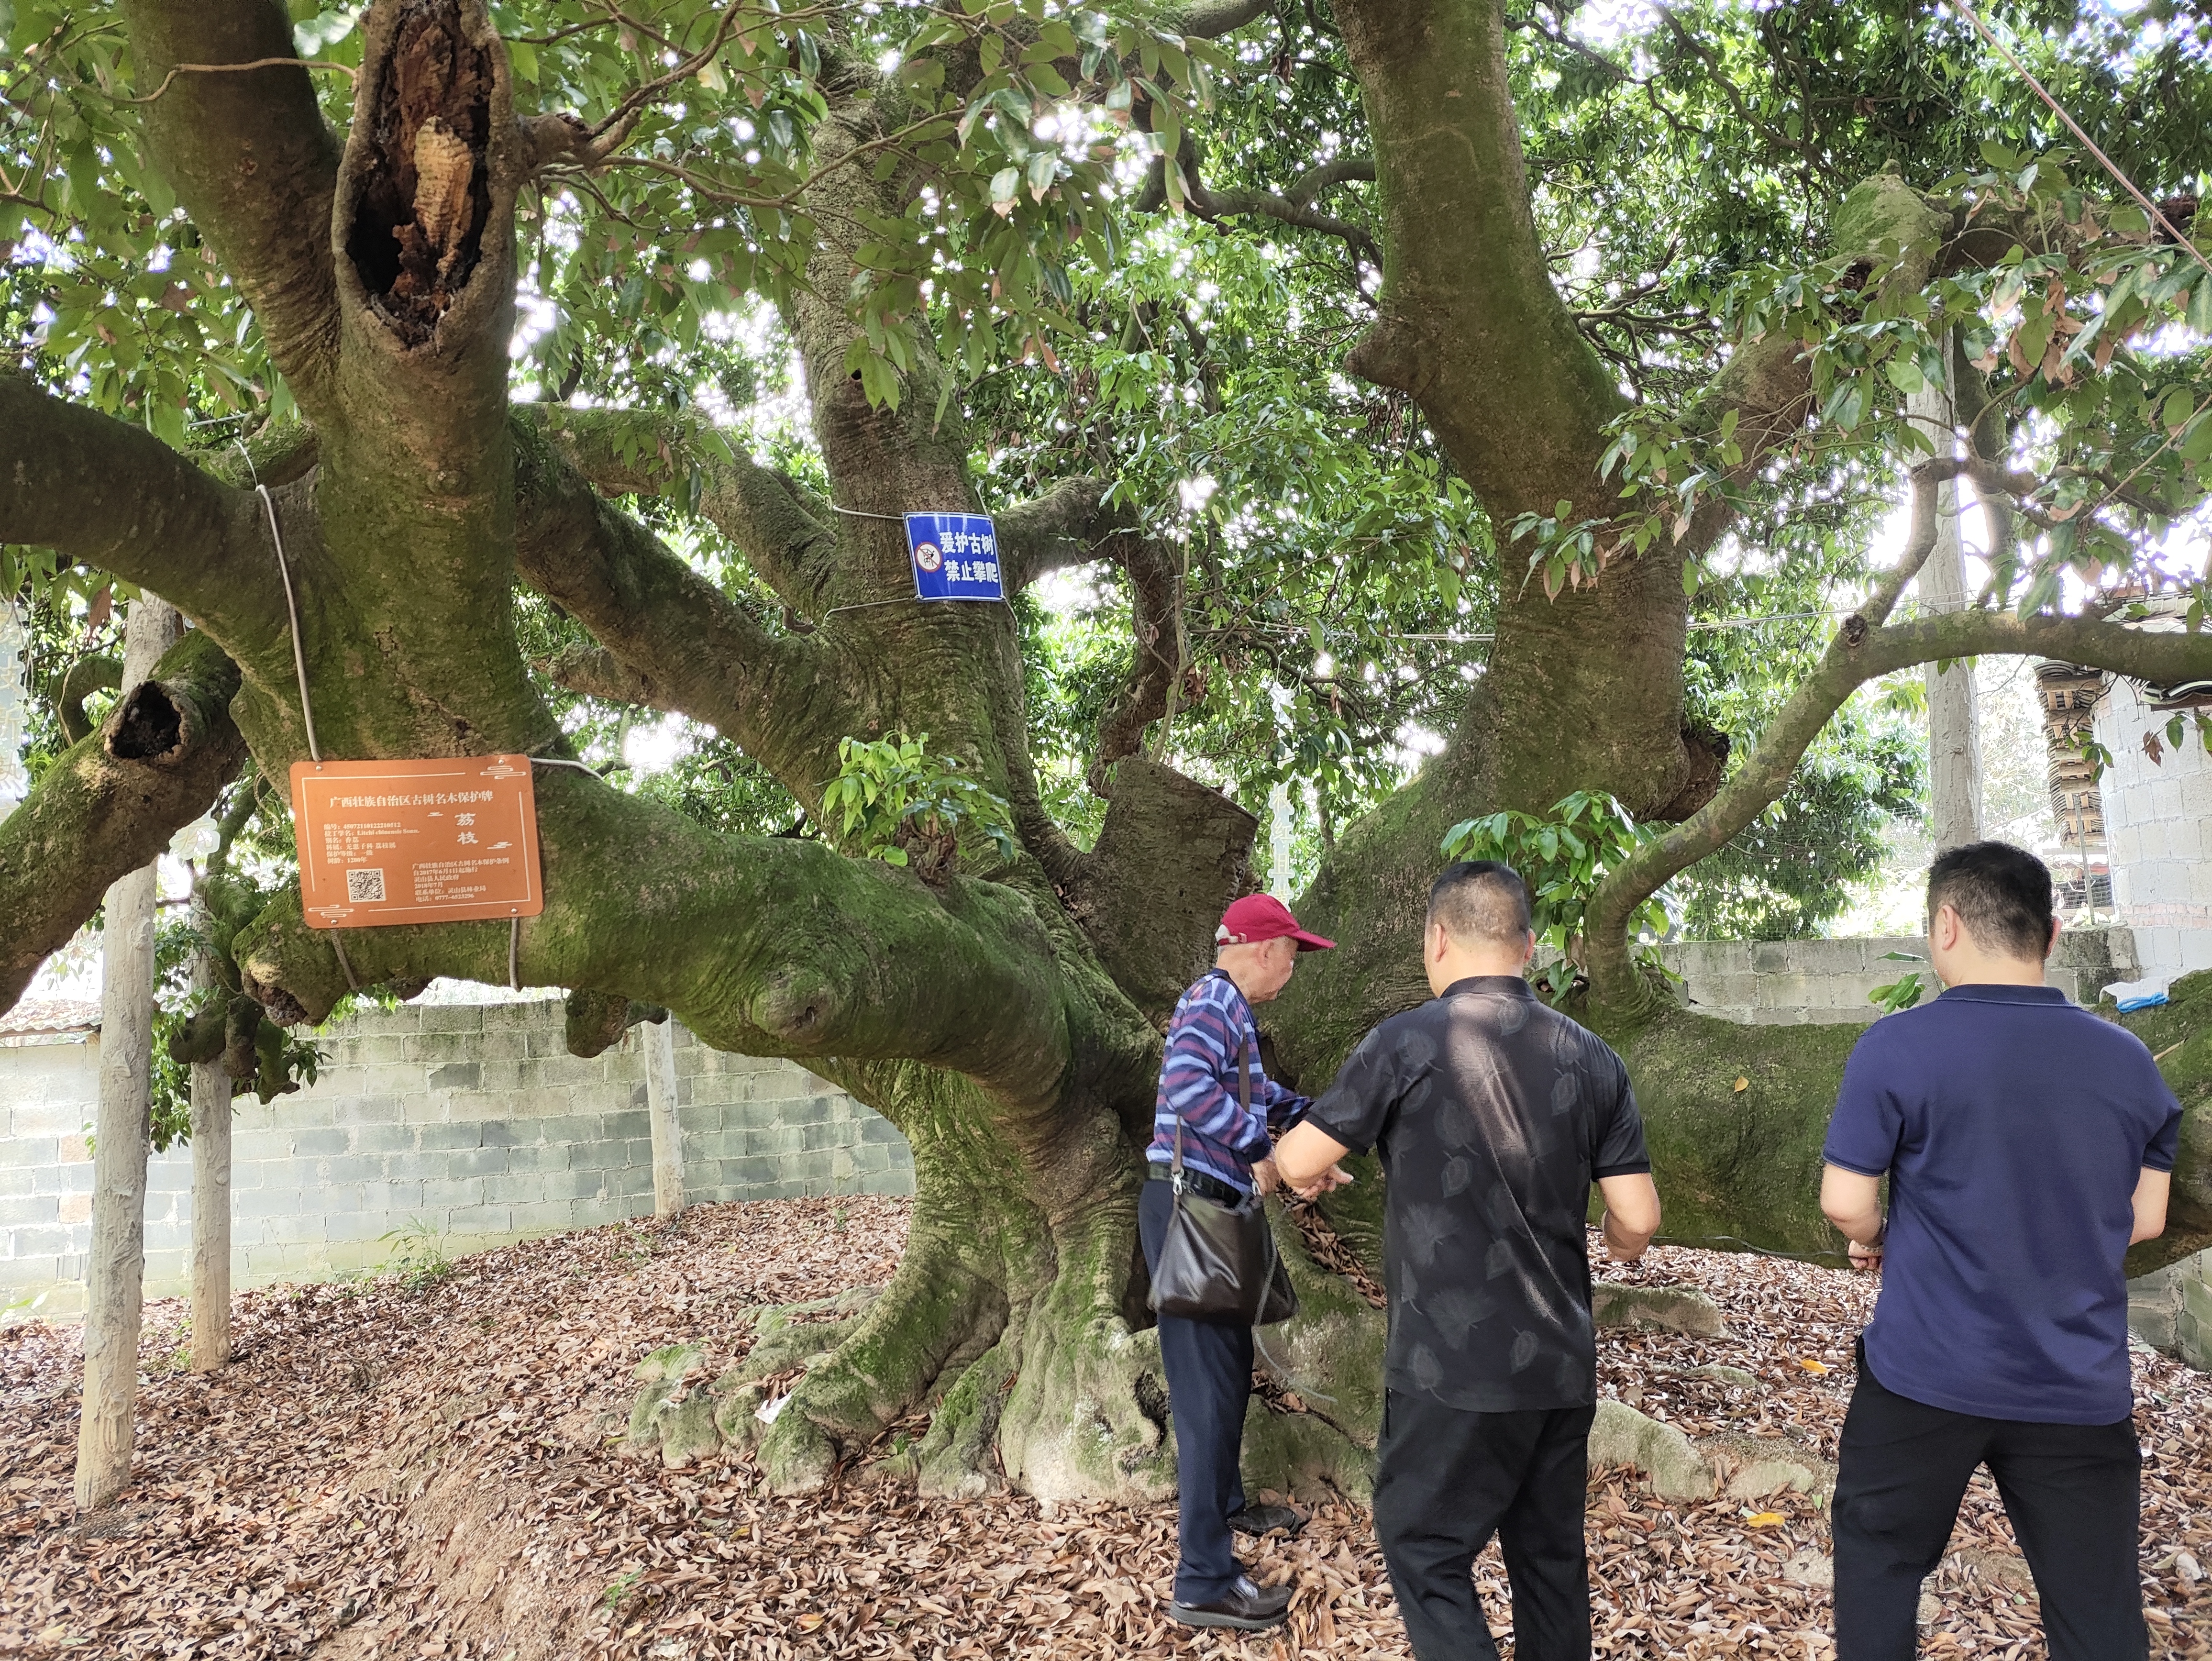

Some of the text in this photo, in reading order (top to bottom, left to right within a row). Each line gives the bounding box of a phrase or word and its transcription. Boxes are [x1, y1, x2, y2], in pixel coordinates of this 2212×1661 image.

[939, 532, 994, 555] 爱护古树
[944, 560, 998, 583] 禁止攀爬
[330, 790, 493, 808] 广西壮族自治区古树名木保护牌
[454, 813, 479, 845] 荔枝
[412, 857, 509, 870] 广西壮族自治区古树名木保护条例
[414, 875, 459, 883] 灵山县人民政府
